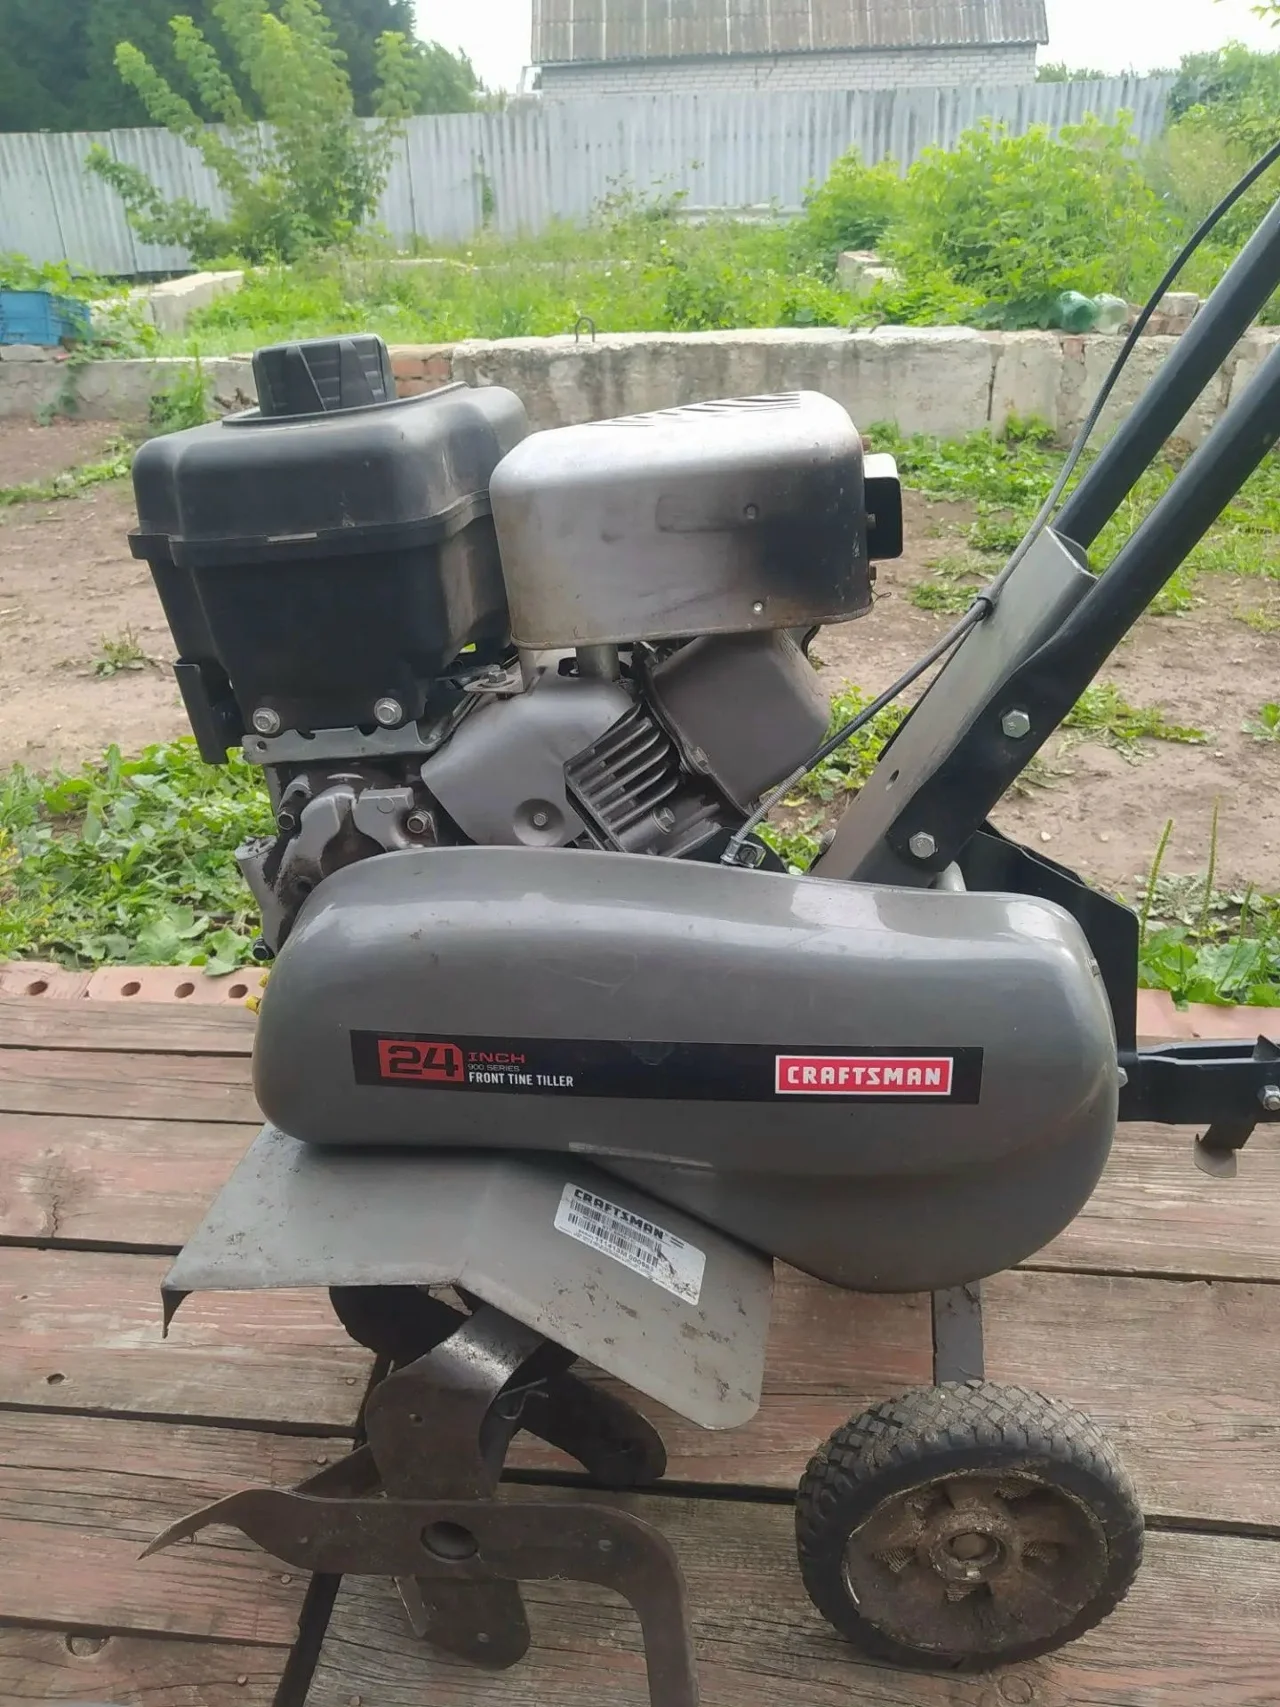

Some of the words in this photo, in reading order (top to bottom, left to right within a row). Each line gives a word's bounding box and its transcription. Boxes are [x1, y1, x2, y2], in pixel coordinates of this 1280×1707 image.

[388, 1045, 459, 1077] 24
[468, 1052, 525, 1063] INCH
[486, 1064, 520, 1072] SERIES
[787, 1066, 941, 1086] CRAFTSMAN
[469, 1071, 505, 1084] FRONT
[507, 1073, 534, 1086] TINE
[536, 1074, 574, 1087] TILLER
[574, 1188, 664, 1240] CRAFTSMAN
